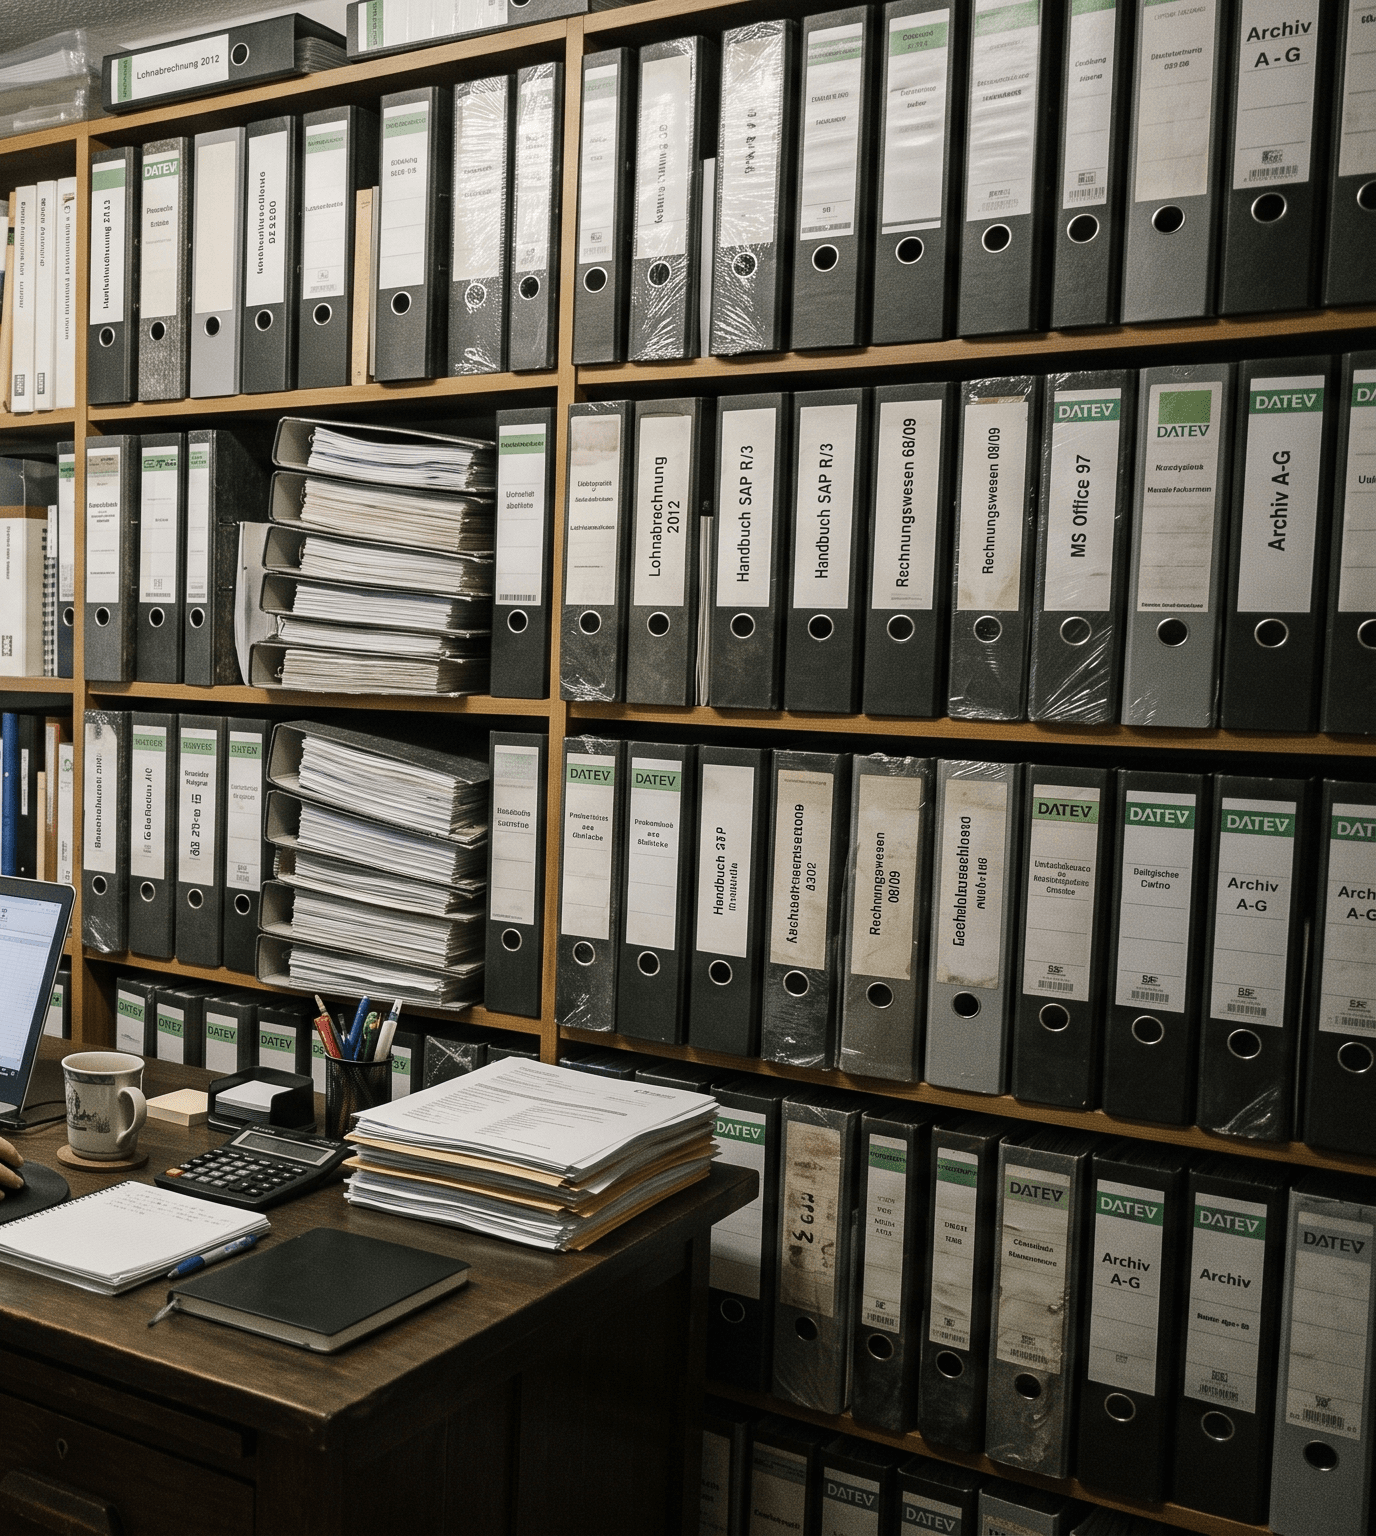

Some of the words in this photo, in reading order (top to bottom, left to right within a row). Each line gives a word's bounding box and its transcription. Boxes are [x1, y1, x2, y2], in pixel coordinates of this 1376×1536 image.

[1246, 19, 1312, 42] Archiv
[200, 54, 220, 67] 2012
[1058, 402, 1114, 418] DATEV
[1255, 393, 1317, 410] DATEV
[902, 418, 916, 457] 68/09
[1156, 424, 1210, 438] DATEV
[740, 445, 754, 471] R/3
[819, 443, 834, 468] R/3
[1076, 454, 1091, 474] 97
[1272, 450, 1291, 486] A-G
[740, 476, 753, 506] SAP
[818, 474, 832, 504] SAP
[1072, 480, 1090, 527] Office
[648, 456, 667, 577] Lohnabrechnung
[667, 500, 680, 534] 2012
[896, 461, 915, 588] Rechnungswesen
[982, 463, 1000, 574] Rechnungswesen
[1268, 492, 1289, 552] Archiv
[736, 512, 752, 582] Handbuch
[815, 509, 831, 579] Handbuch
[1070, 533, 1087, 558] MS
[570, 768, 611, 781] DATEV
[636, 773, 676, 786] DATEV
[1038, 802, 1093, 818] DATEV
[1130, 807, 1190, 824] DATEV
[1226, 814, 1290, 832] DATEV
[888, 870, 901, 904] 08/09
[1227, 877, 1279, 892] Archiv
[1236, 898, 1268, 912] A-G
[260, 1034, 292, 1050] DATEV
[716, 1121, 761, 1139] DATEV
[1010, 1181, 1064, 1202] DATEV
[1100, 1196, 1158, 1219] DATEV
[1199, 1210, 1260, 1233] DATEV
[1303, 1231, 1365, 1254] DATEV
[1102, 1252, 1151, 1272] Archiv
[1111, 1274, 1141, 1289] A-G
[1199, 1268, 1252, 1288] Archiv
[827, 1483, 874, 1506] DATEV
[905, 1507, 956, 1533] DATEV
